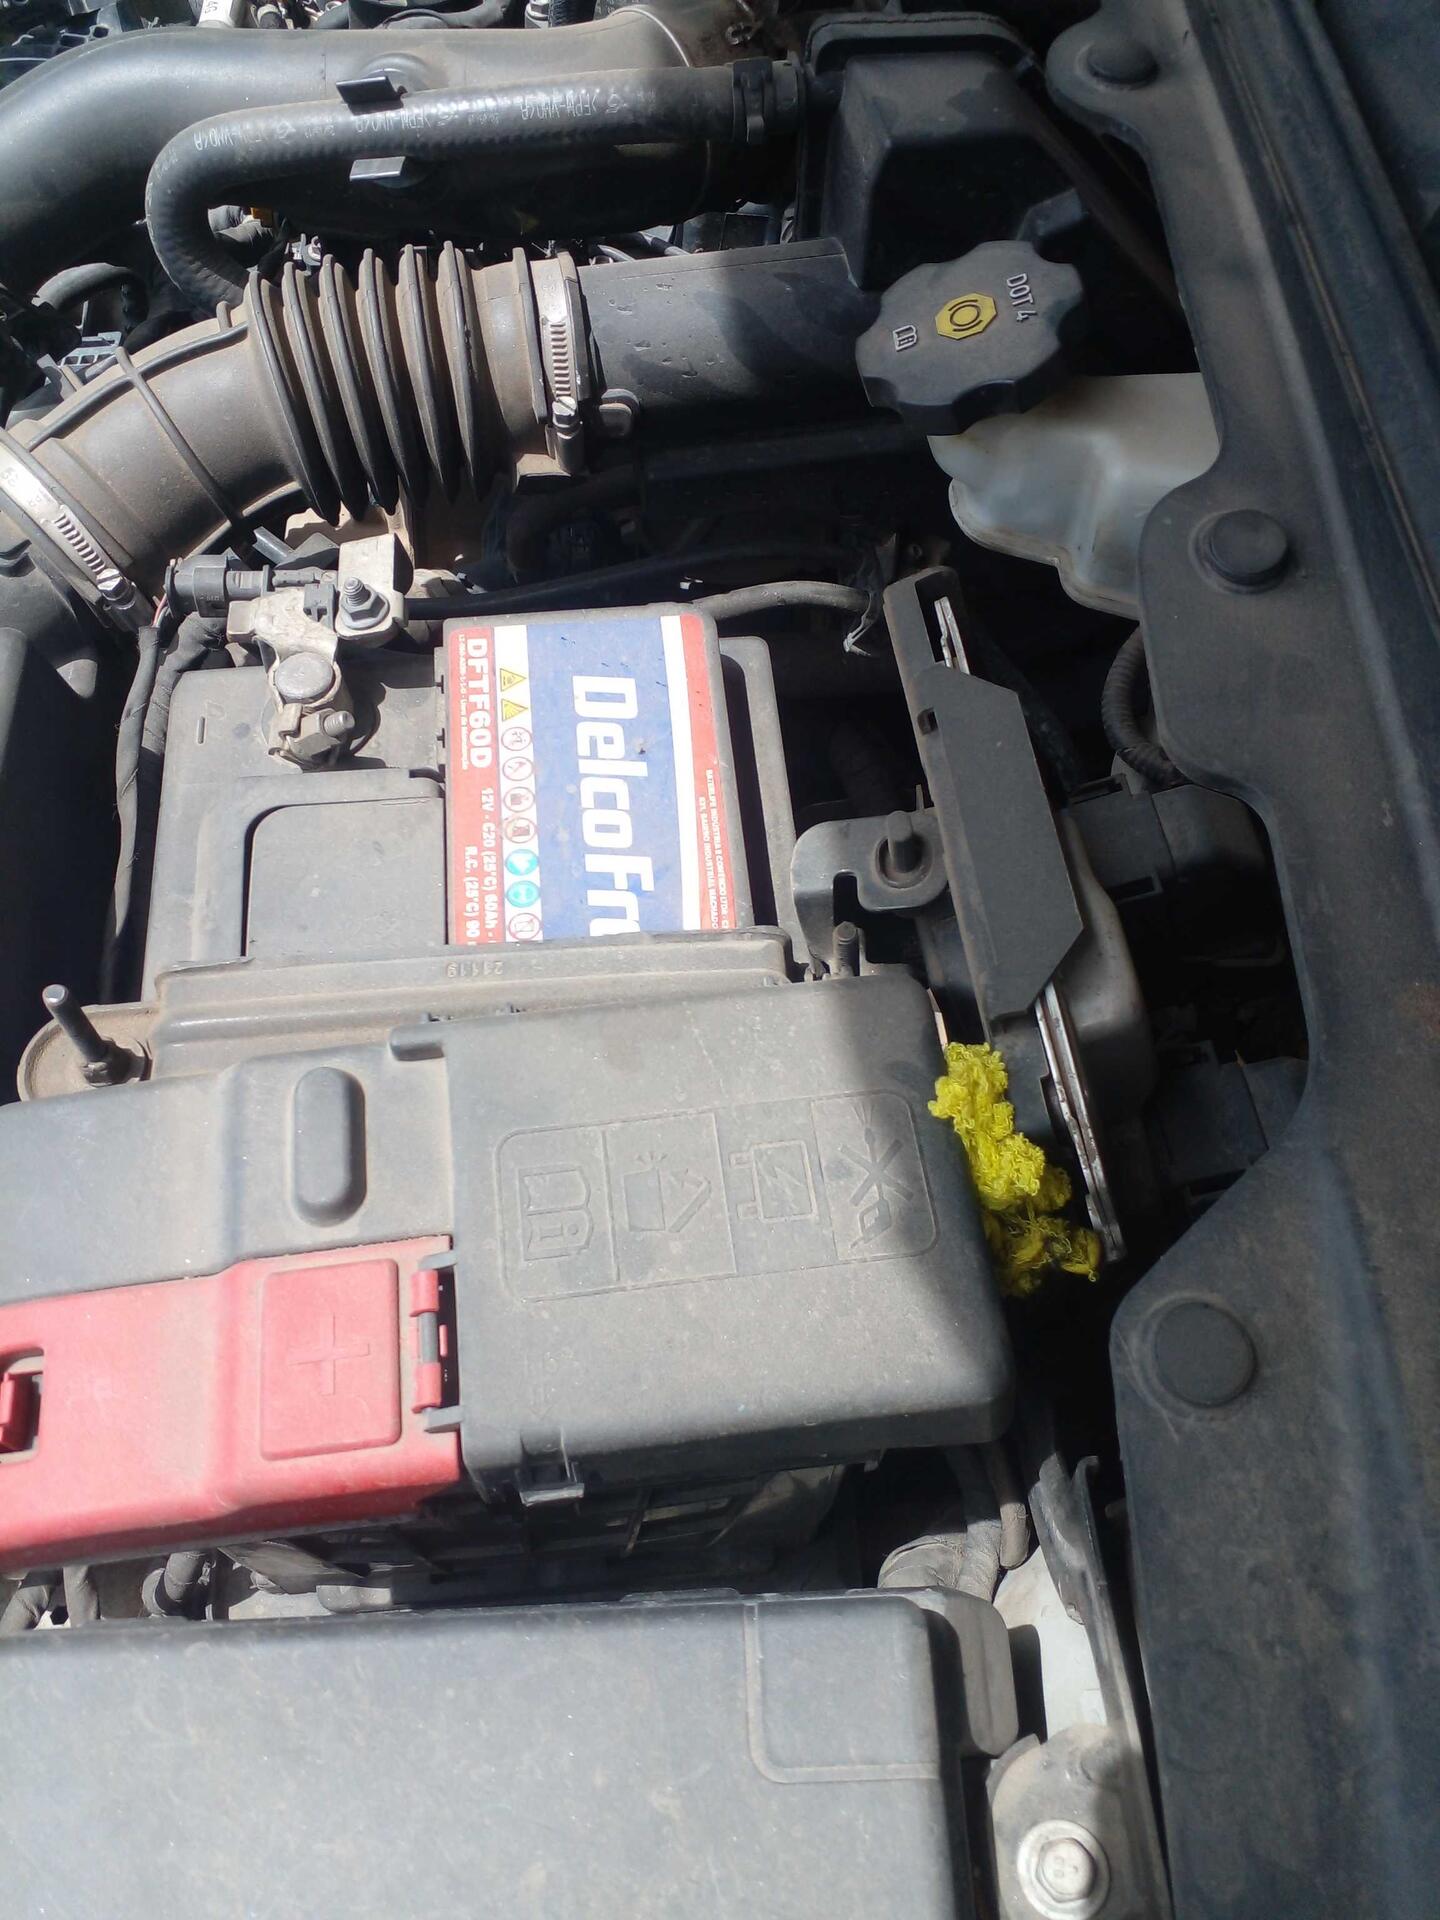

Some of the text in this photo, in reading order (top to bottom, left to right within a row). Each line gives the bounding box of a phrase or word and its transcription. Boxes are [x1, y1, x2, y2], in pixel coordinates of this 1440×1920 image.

[1006, 273, 1037, 322] DOT 4
[466, 638, 493, 768] DFTF60D
[481, 787, 494, 811] 12V
[482, 822, 496, 848] C20
[484, 894, 498, 929] 60Ah
[465, 919, 480, 938] 90
